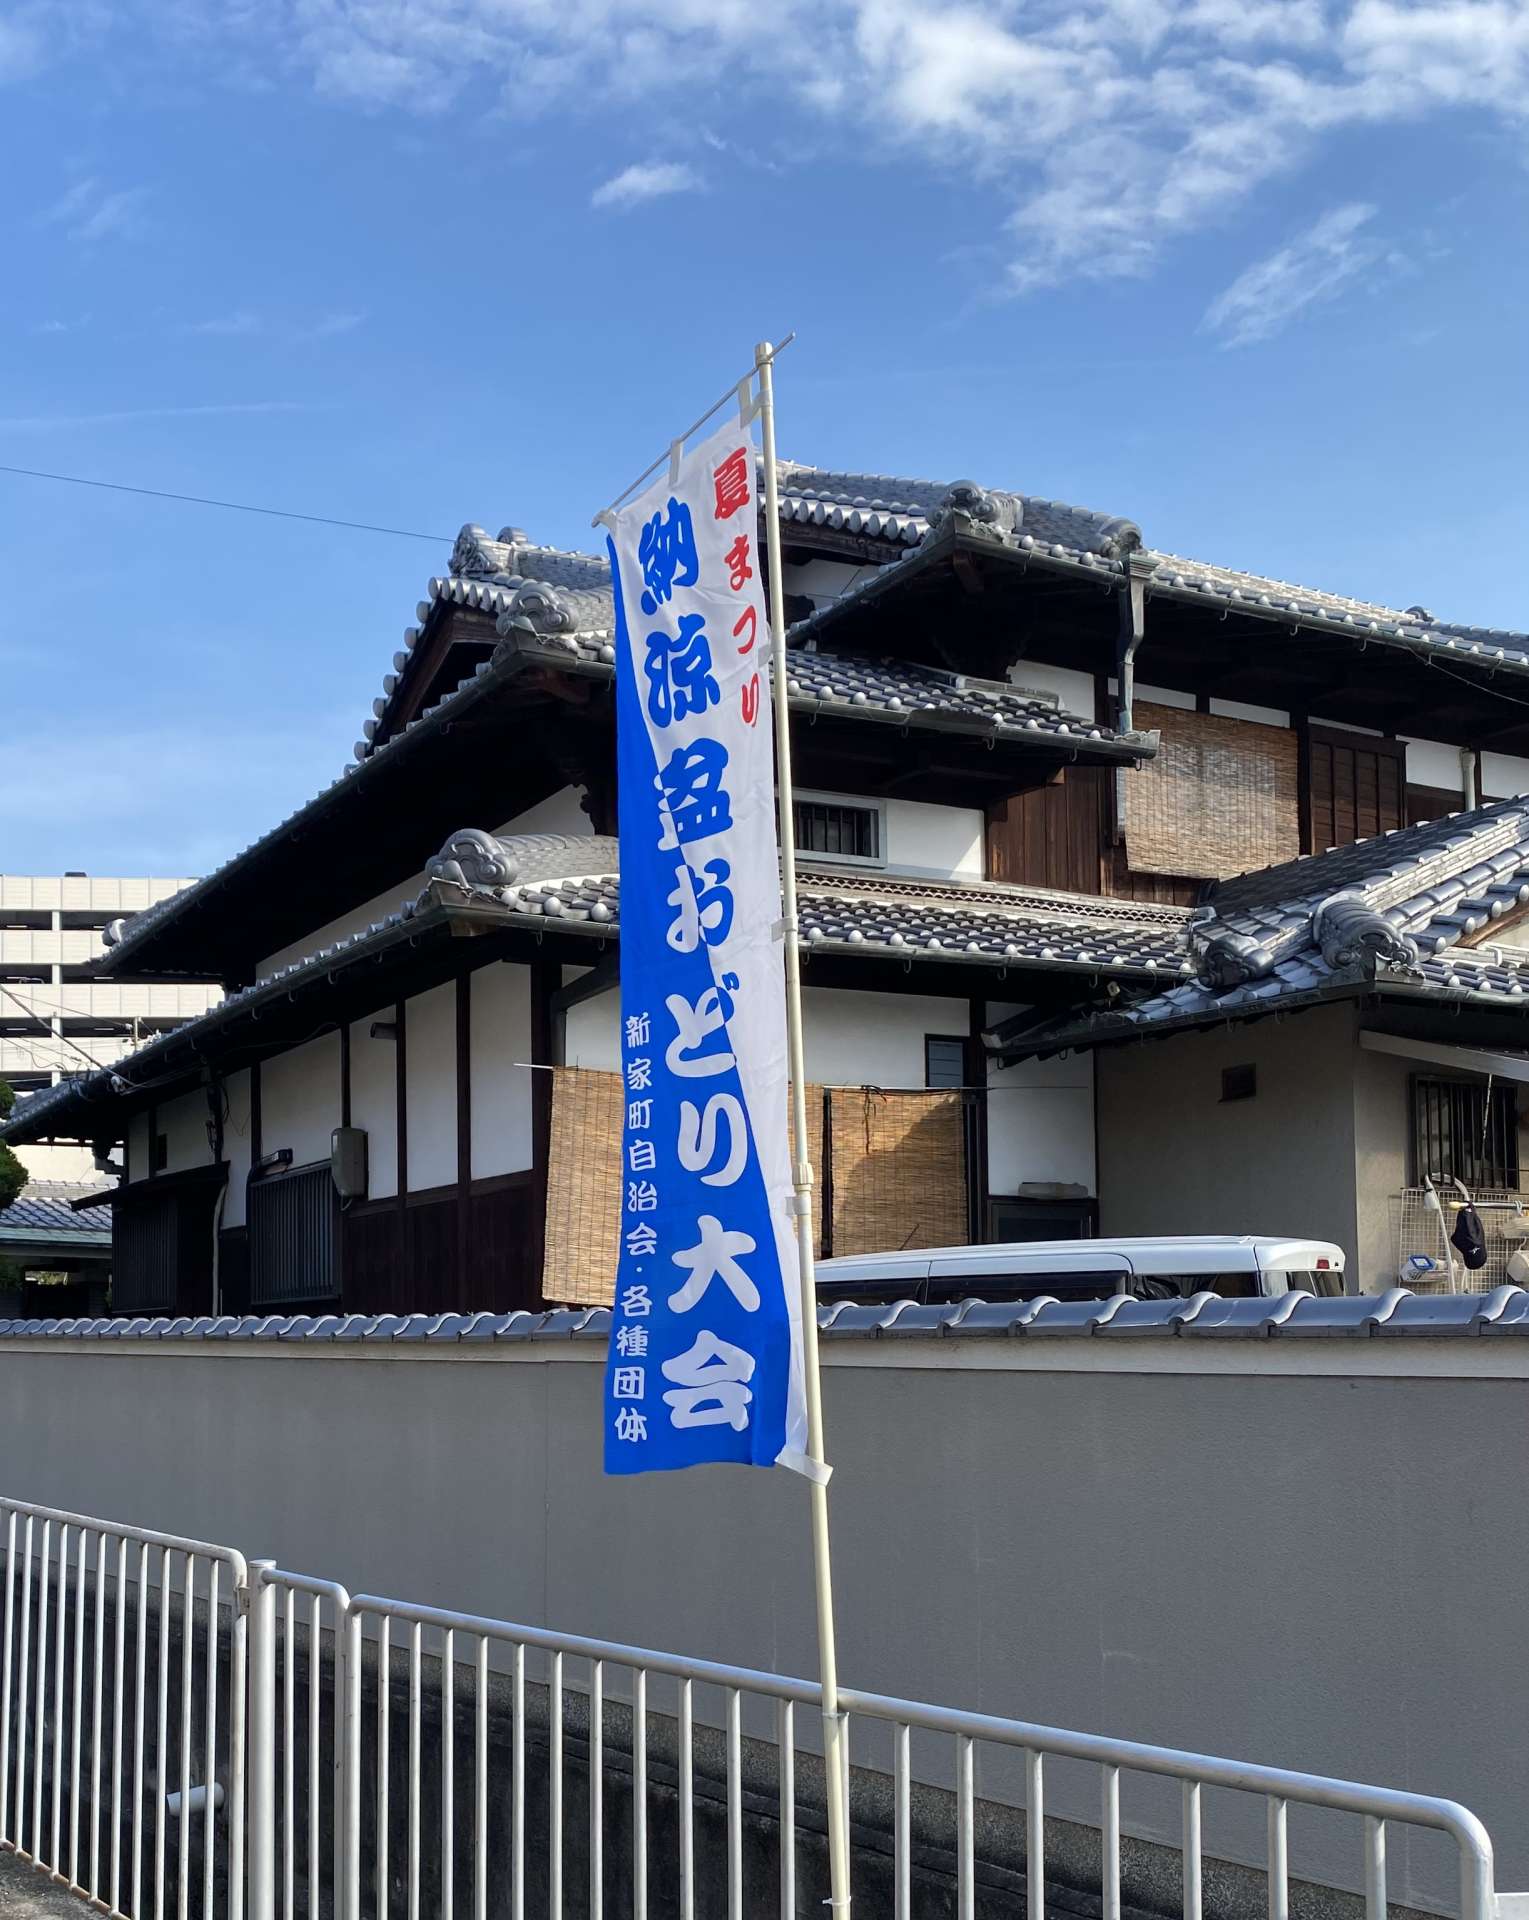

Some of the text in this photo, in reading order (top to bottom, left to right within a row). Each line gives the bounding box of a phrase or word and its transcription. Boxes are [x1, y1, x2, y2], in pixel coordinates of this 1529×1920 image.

[713, 447, 760, 728] 夏まつり
[639, 496, 761, 1432] 納涼盆おどり大会
[613, 1012, 658, 1443] 新家町自治会・各種団体
